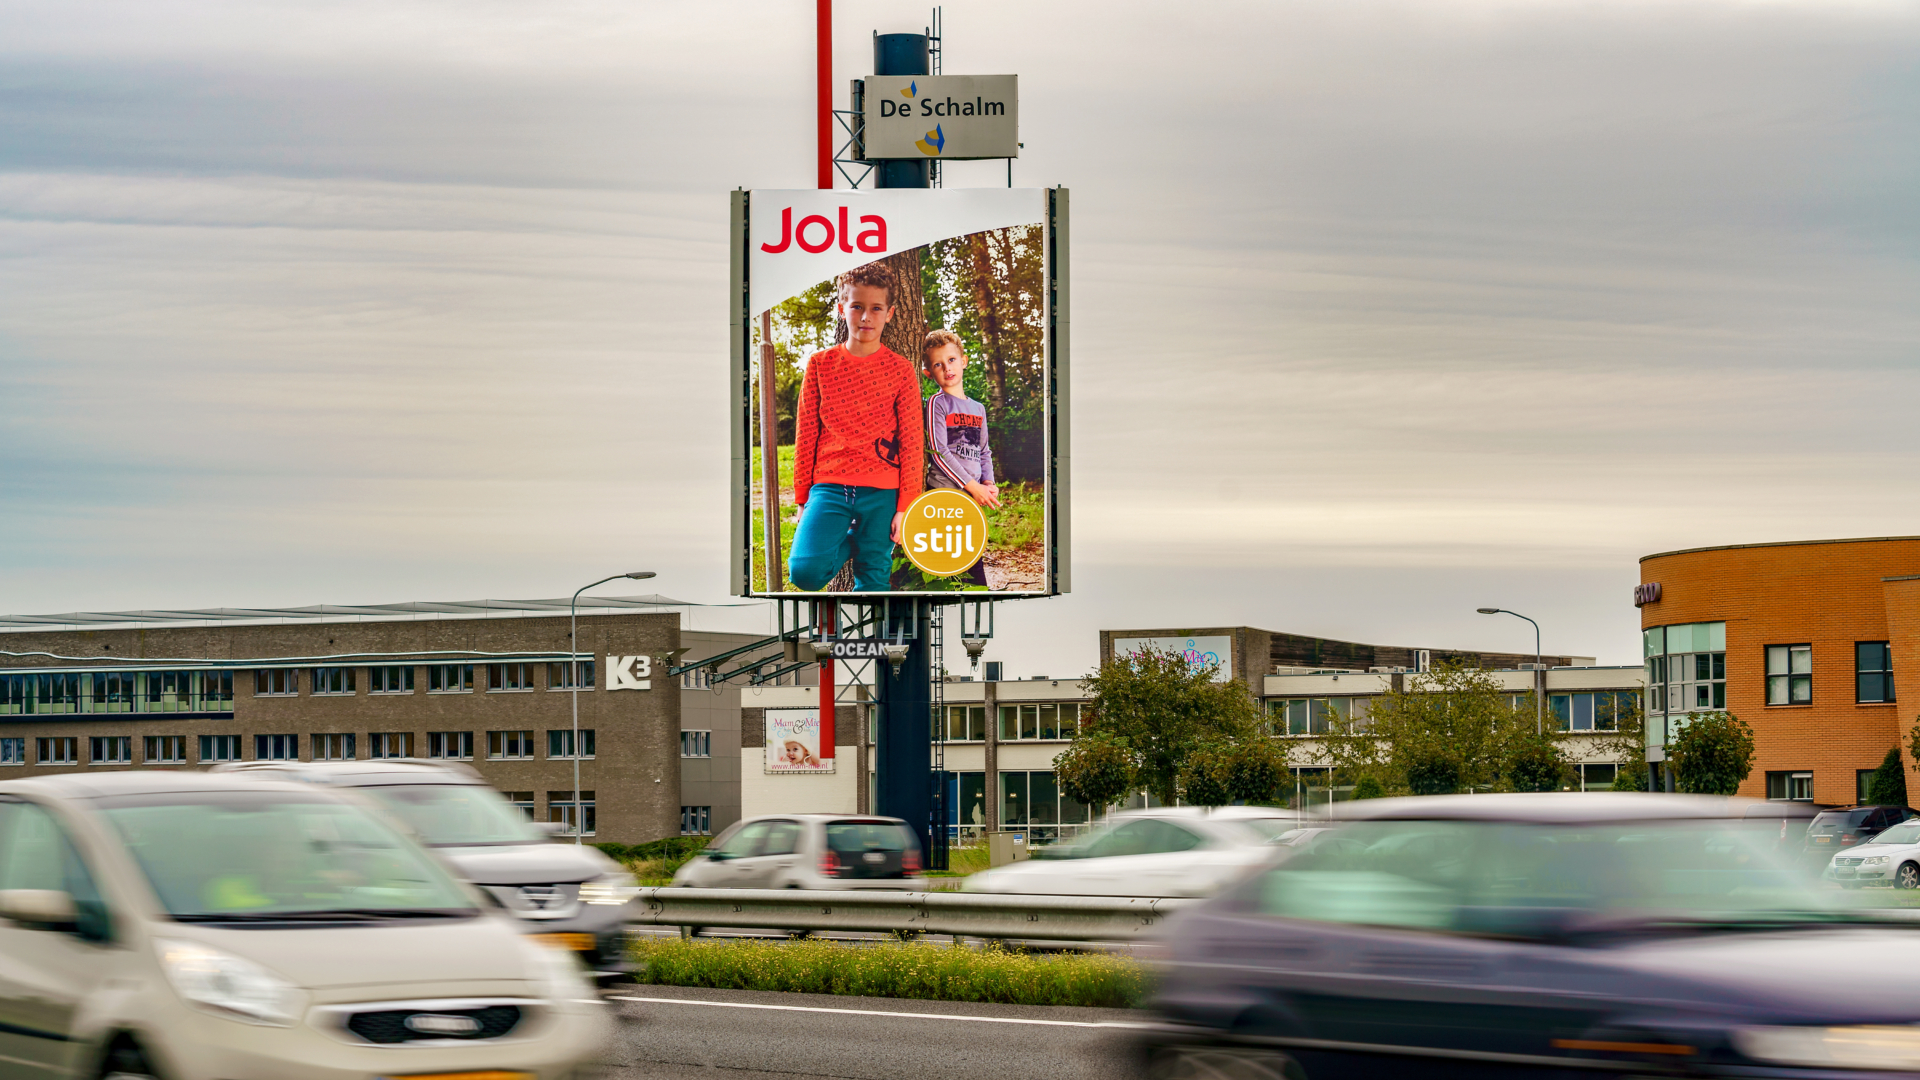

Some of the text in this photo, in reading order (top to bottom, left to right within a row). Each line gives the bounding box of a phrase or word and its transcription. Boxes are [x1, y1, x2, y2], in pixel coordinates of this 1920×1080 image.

[880, 96, 1005, 118] De Schalm
[760, 206, 888, 254] Jola
[923, 504, 964, 519] Onze
[913, 524, 975, 559] stijl
[834, 642, 890, 657] OCEAN
[1182, 649, 1206, 664] Mie
[774, 718, 794, 727] Mam
[793, 719, 806, 735] &
[805, 717, 821, 727] Mie
[771, 762, 829, 770] www.mam-mie.nl
